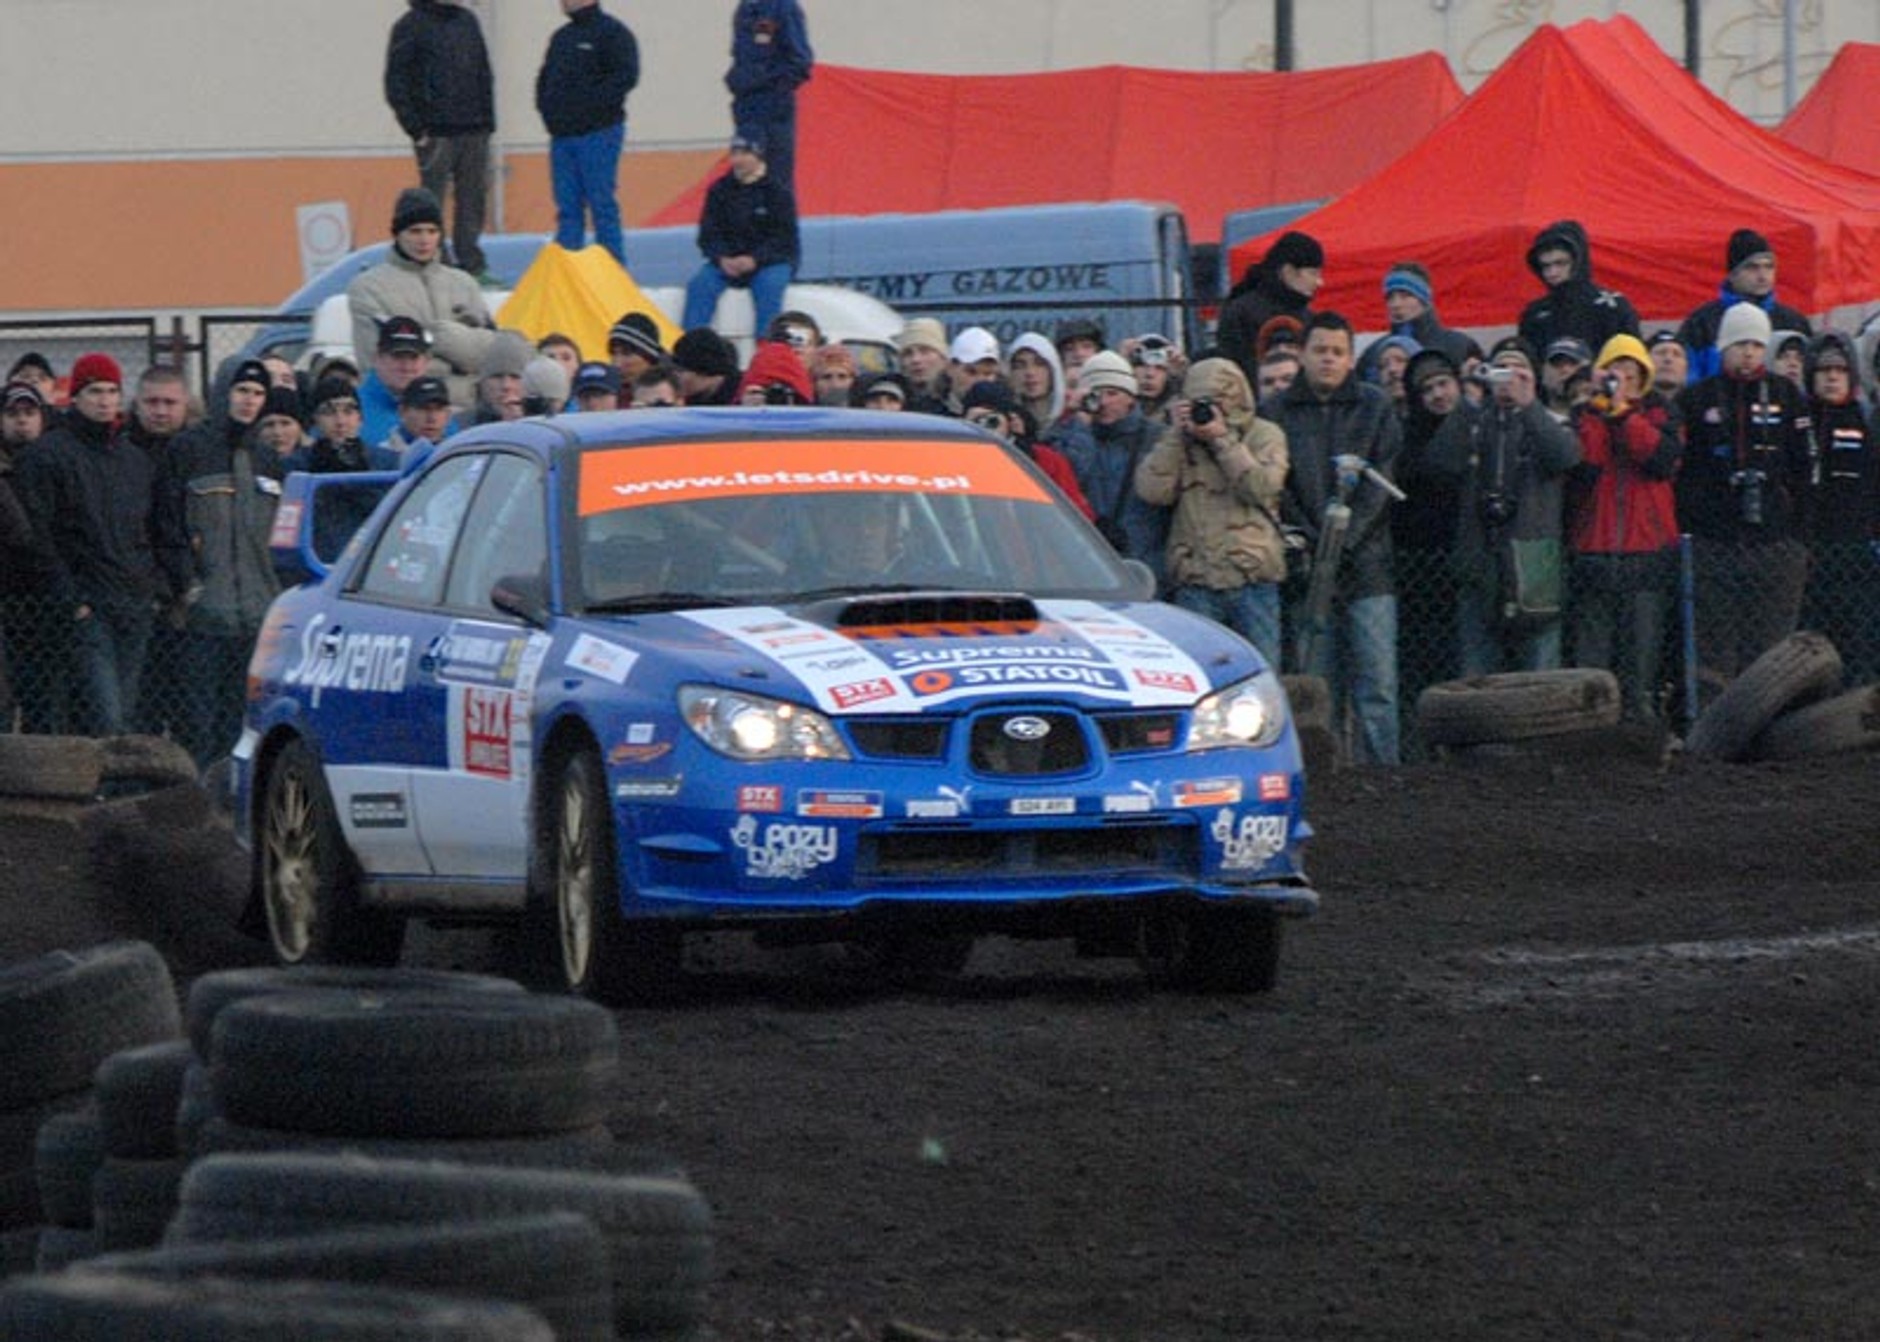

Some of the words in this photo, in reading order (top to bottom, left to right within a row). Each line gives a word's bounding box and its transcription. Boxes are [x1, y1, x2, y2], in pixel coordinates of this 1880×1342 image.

[952, 264, 1109, 295] GAZOWE
[283, 612, 412, 709] Suprema
[892, 645, 1094, 666] Suprema
[959, 664, 1116, 687] STATOIL
